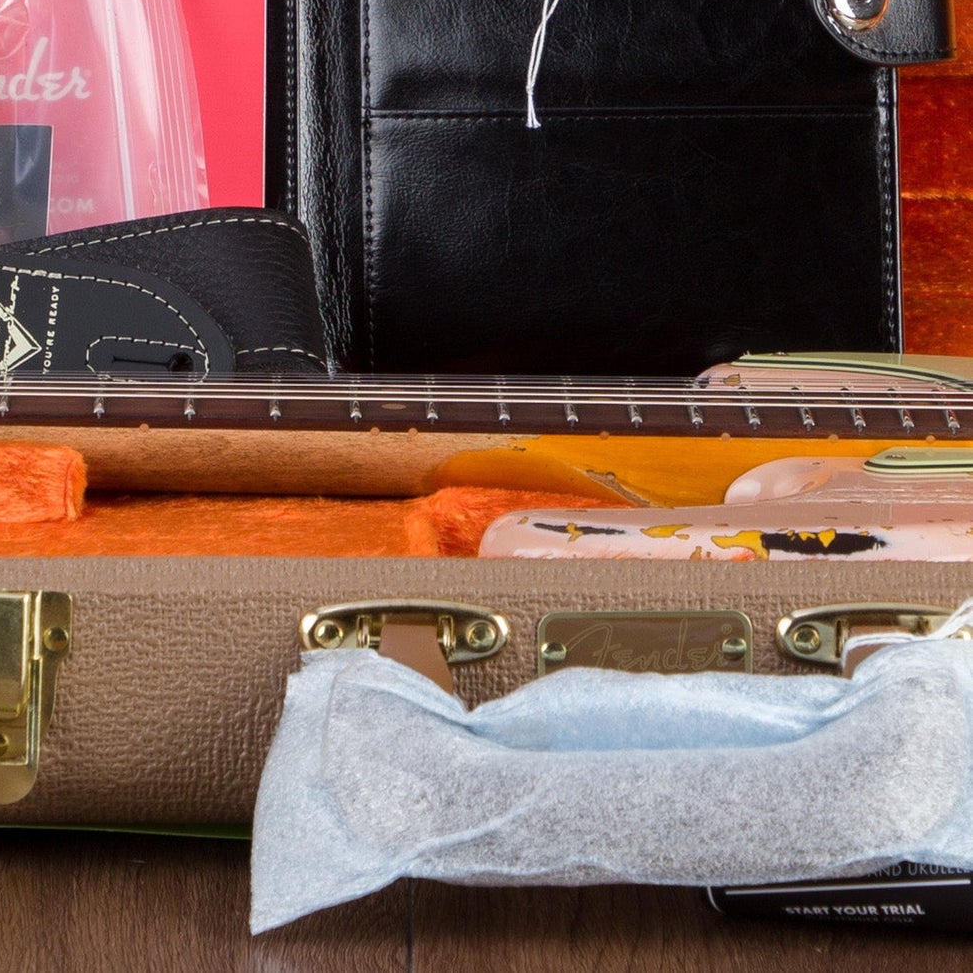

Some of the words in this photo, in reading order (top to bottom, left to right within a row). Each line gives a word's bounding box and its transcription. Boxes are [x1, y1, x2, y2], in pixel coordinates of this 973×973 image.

[43, 331, 55, 374] YOU'RE
[49, 286, 59, 325] READY
[785, 908, 828, 916] START
[833, 907, 878, 916] YOUR
[881, 905, 925, 915] TRIAL
